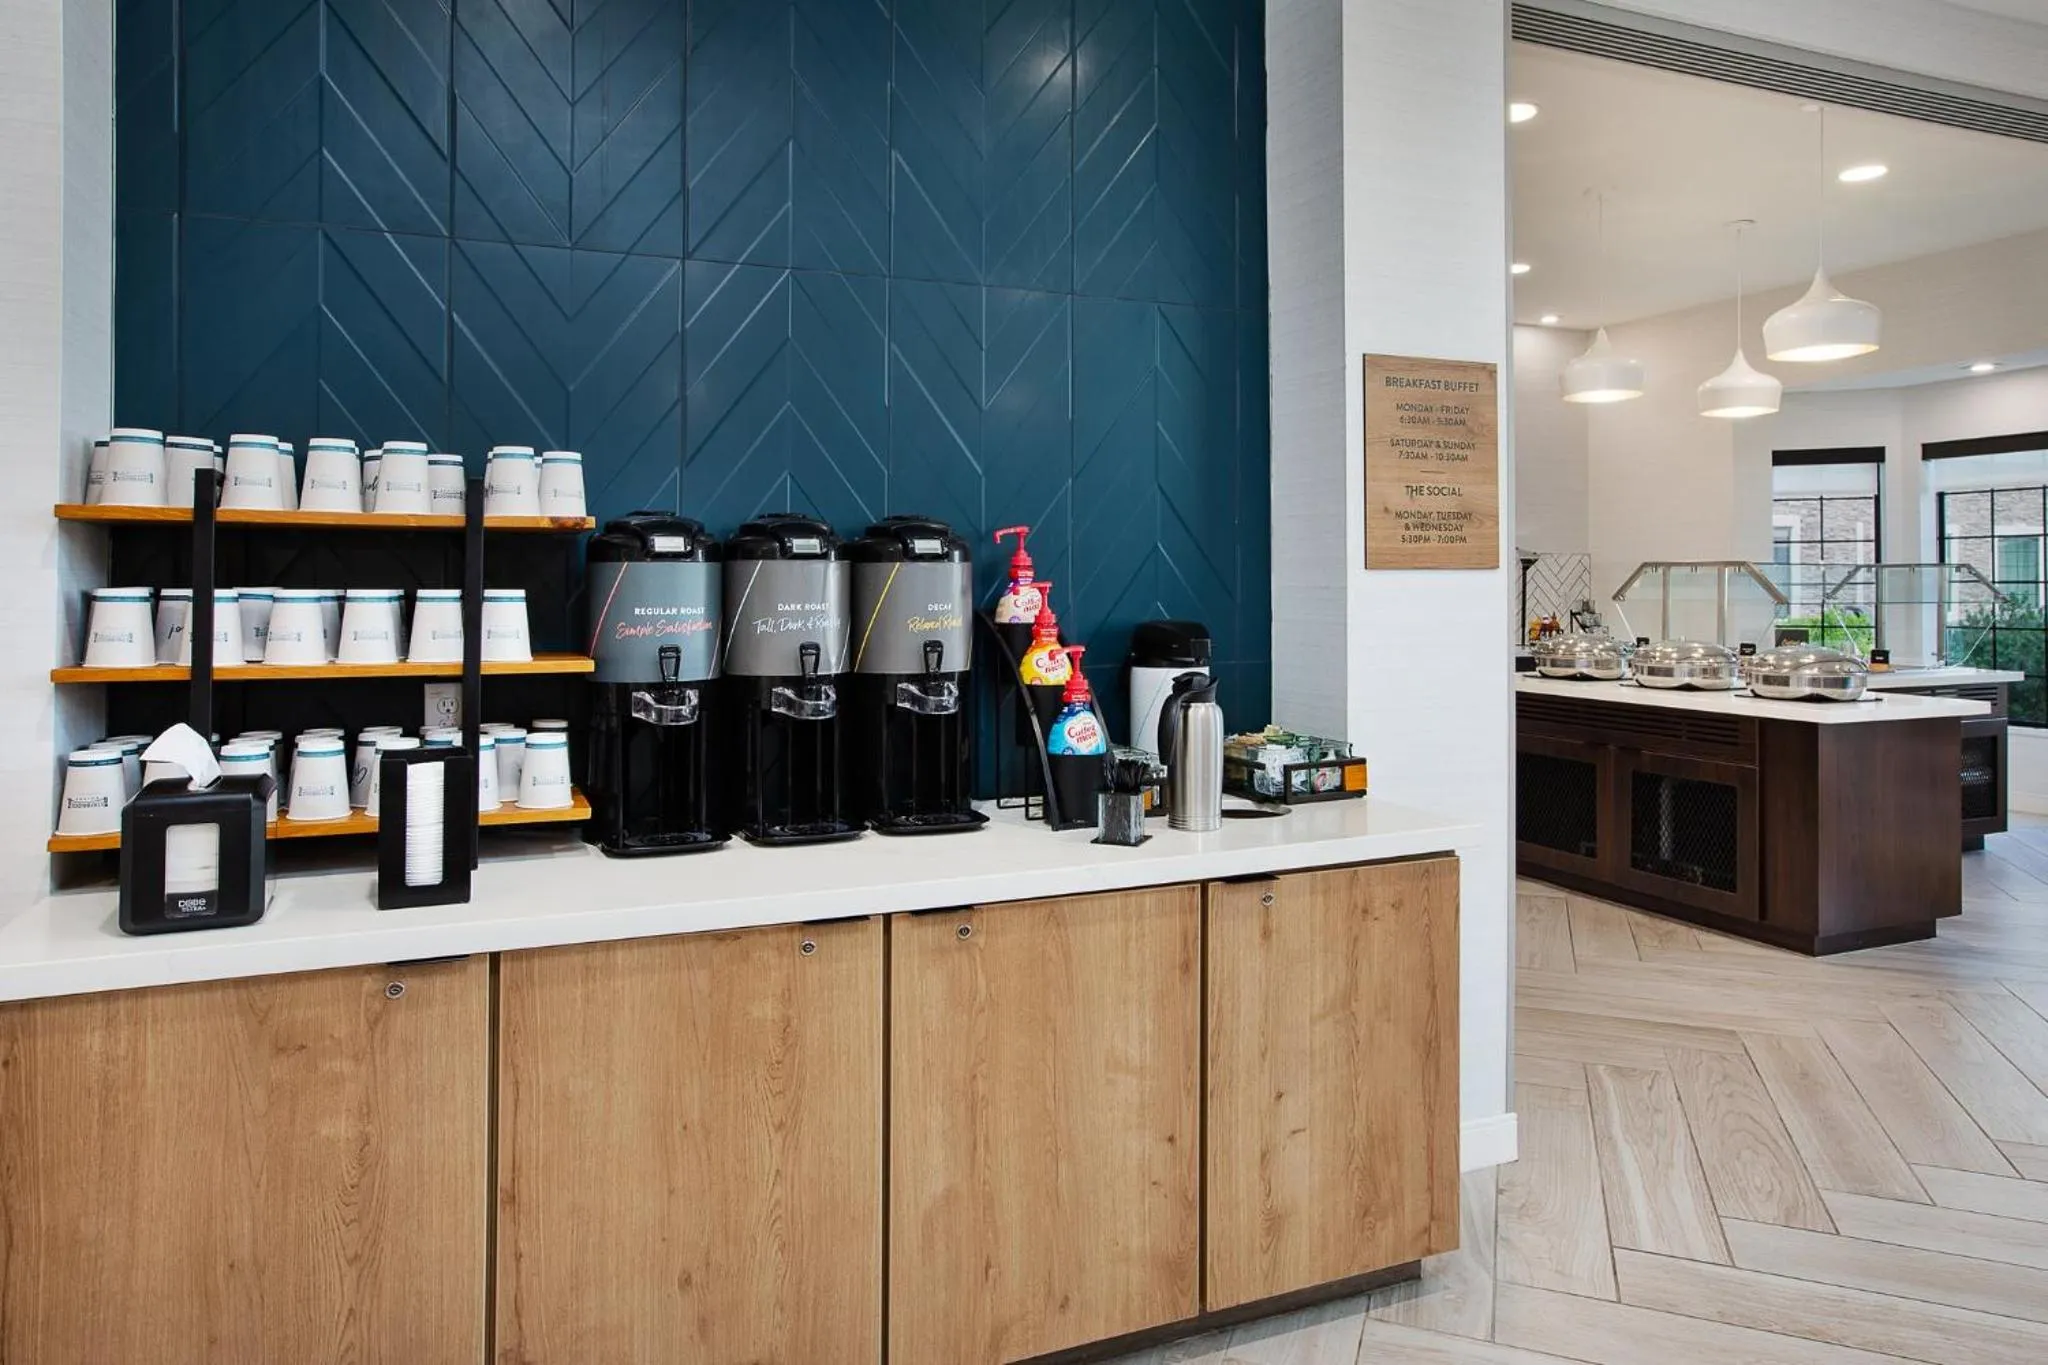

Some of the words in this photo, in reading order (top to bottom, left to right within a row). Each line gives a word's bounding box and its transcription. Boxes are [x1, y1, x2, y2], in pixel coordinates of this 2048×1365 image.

[1385, 376, 1441, 390] BREAKFAST
[1444, 380, 1480, 393] BUFFET
[1396, 402, 1434, 413] MONDAY
[1441, 404, 1471, 415] FRIDAY
[1389, 438, 1434, 449] SATURDAY
[1443, 440, 1477, 451] SUNDAY
[1405, 485, 1425, 497] THE
[1426, 486, 1464, 497] SOCIAL
[1436, 511, 1473, 521] TUESDAY
[1412, 523, 1465, 533] WEDNESDAY
[1401, 534, 1431, 544] 5:30PM
[634, 606, 678, 616] REGULAR
[680, 606, 705, 616] ROAST
[777, 602, 802, 611] DARK
[804, 602, 830, 611] ROAST
